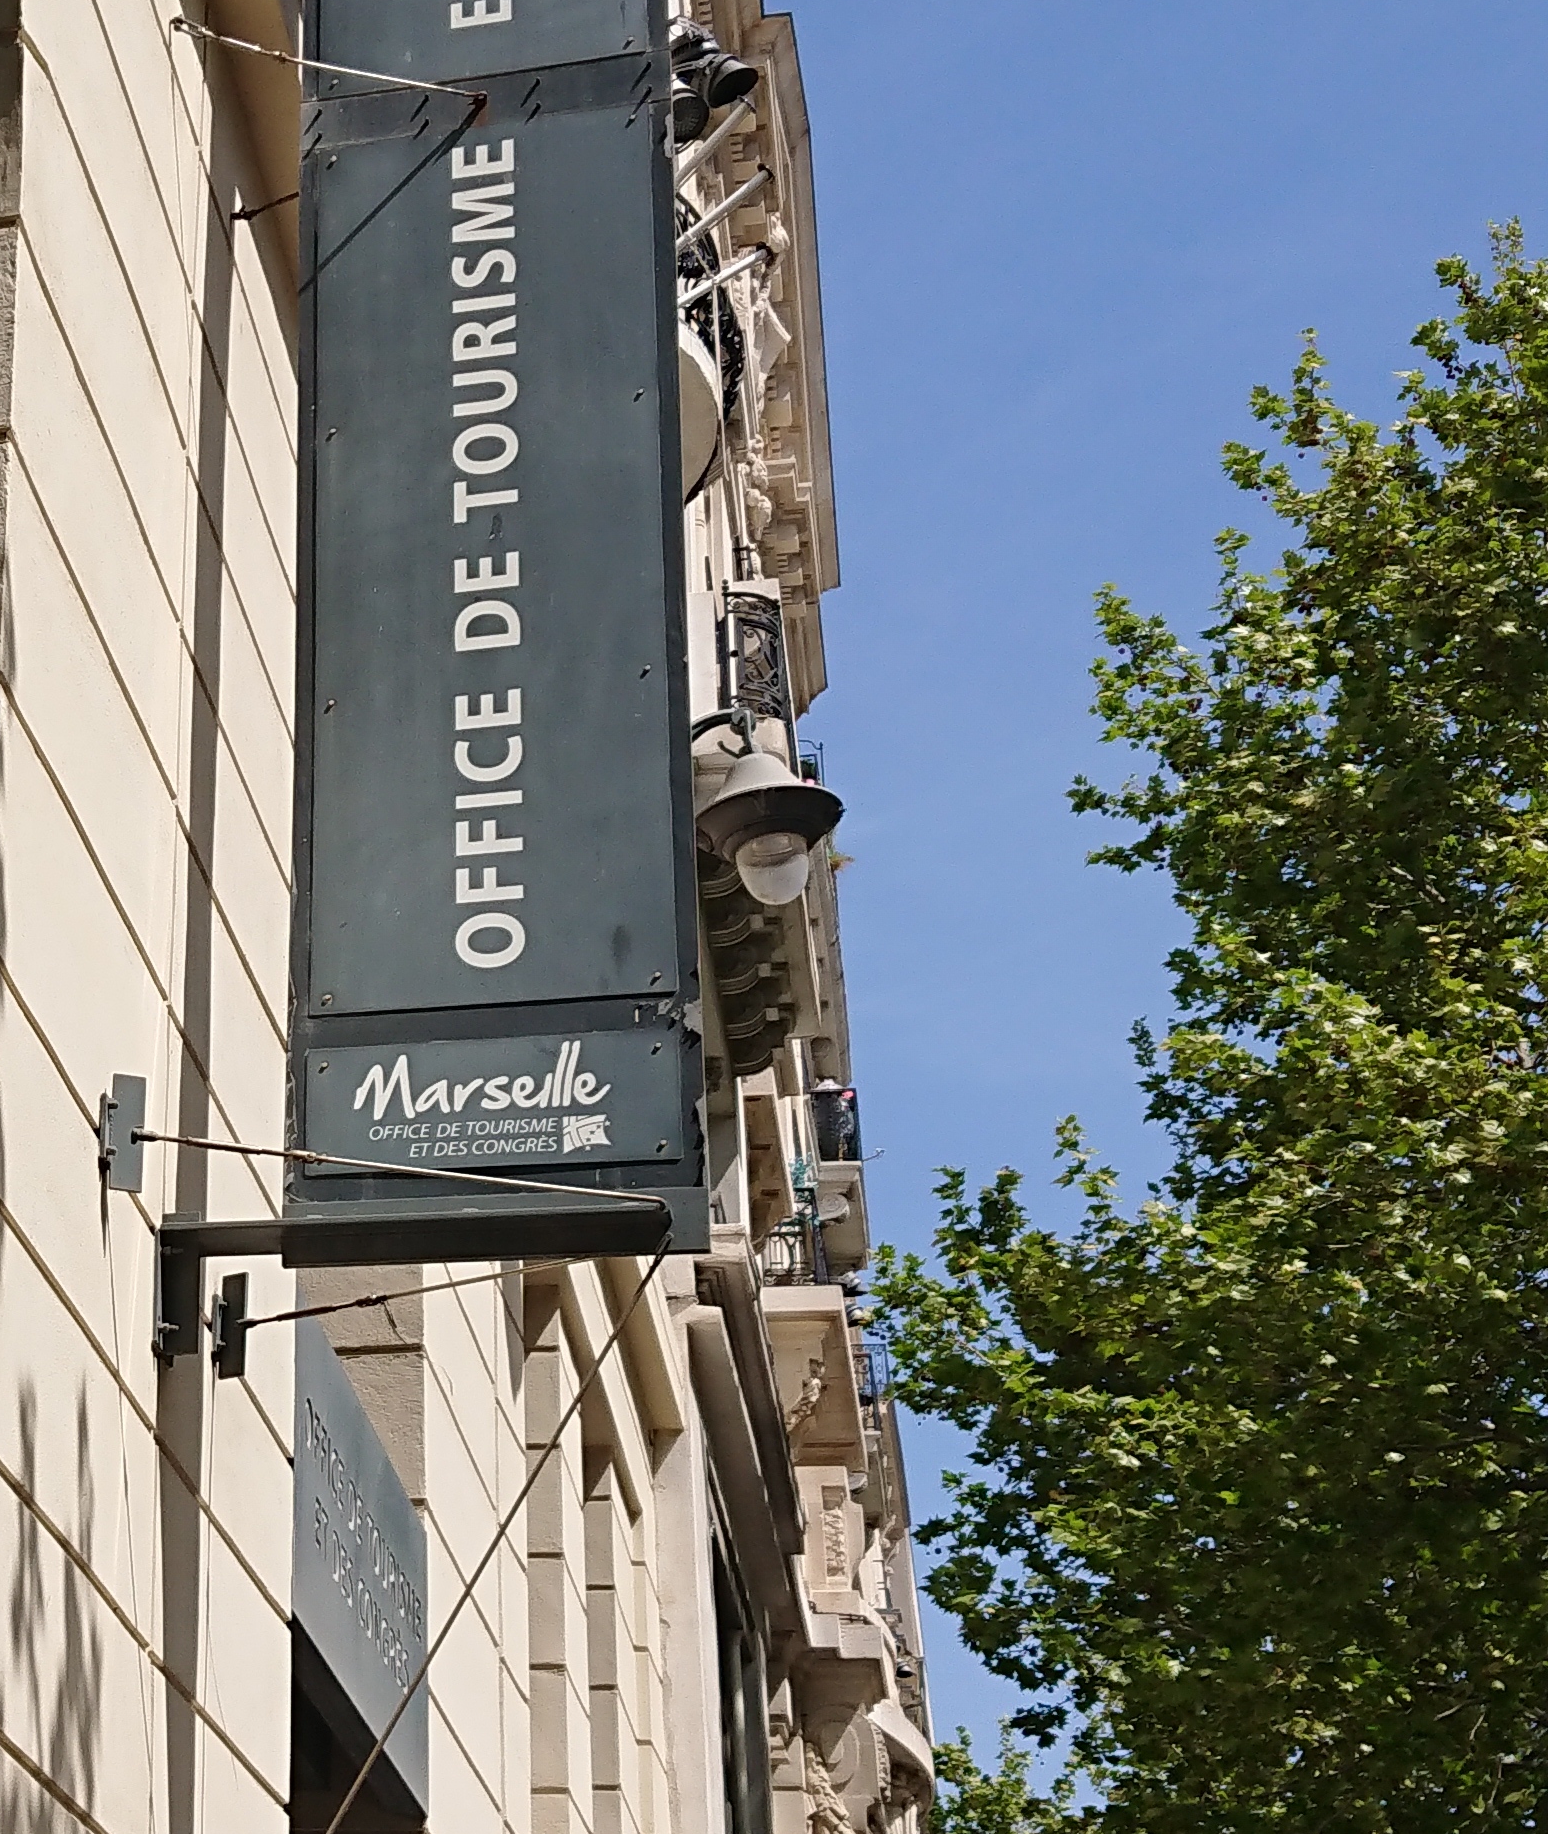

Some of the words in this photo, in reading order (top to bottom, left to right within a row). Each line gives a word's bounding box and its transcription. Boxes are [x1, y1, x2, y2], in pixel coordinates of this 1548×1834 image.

[451, 136, 522, 524] TOURISME
[454, 550, 523, 653] DE
[455, 687, 525, 968] OFFICE
[354, 1040, 611, 1120] Marseille
[369, 1123, 430, 1141] OFFICE
[436, 1121, 460, 1138] DE
[466, 1117, 559, 1136] TOURISME
[409, 1143, 430, 1158] ET
[433, 1141, 468, 1157] DES
[472, 1135, 558, 1154] CONGRÈS
[304, 1397, 345, 1510] OFFICE
[348, 1478, 363, 1546] DE
[366, 1515, 422, 1643] TOURISME
[314, 1496, 328, 1559] ET
[332, 1531, 353, 1608] DES
